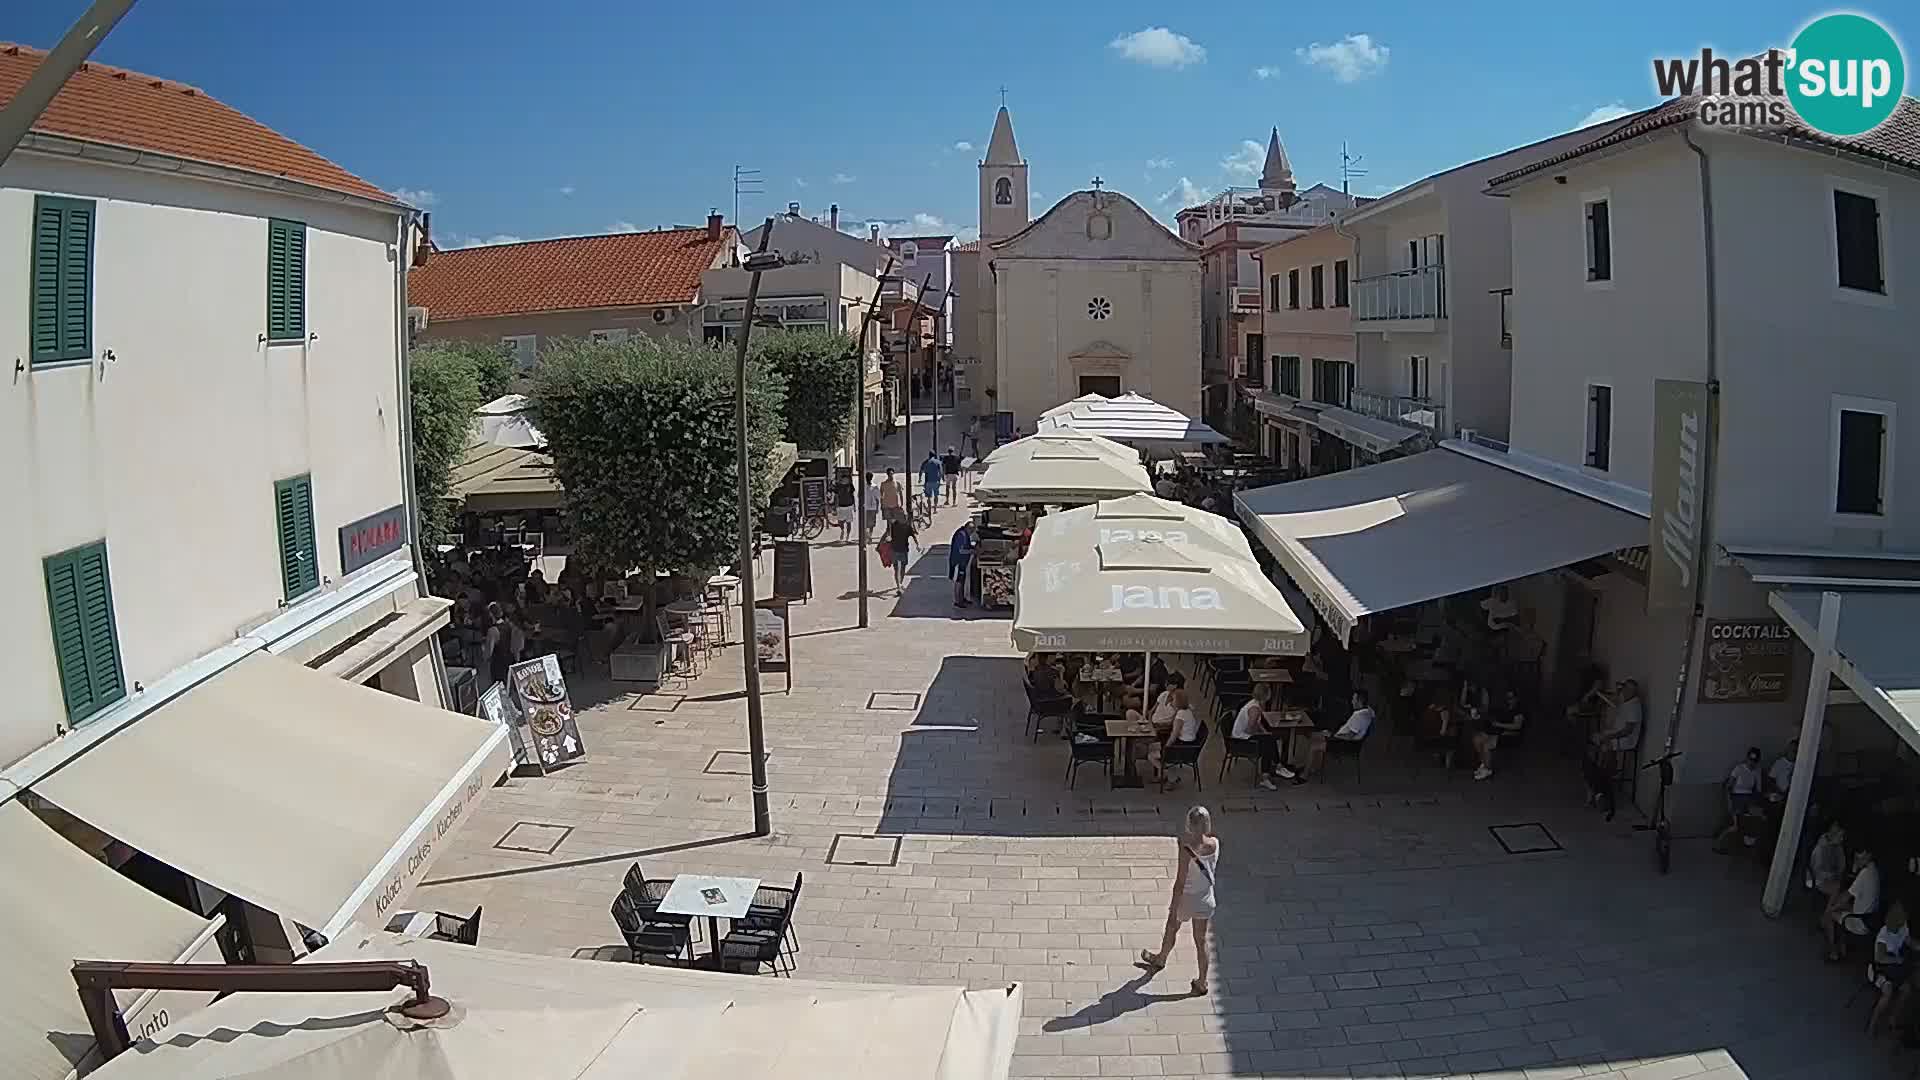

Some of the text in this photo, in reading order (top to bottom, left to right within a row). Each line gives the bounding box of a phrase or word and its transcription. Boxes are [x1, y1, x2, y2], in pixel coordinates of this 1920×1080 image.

[1711, 624, 1791, 639] COCKTAILS
[408, 840, 431, 876] Cakes
[436, 801, 462, 841] Kuchen
[135, 1009, 169, 1040] lato
